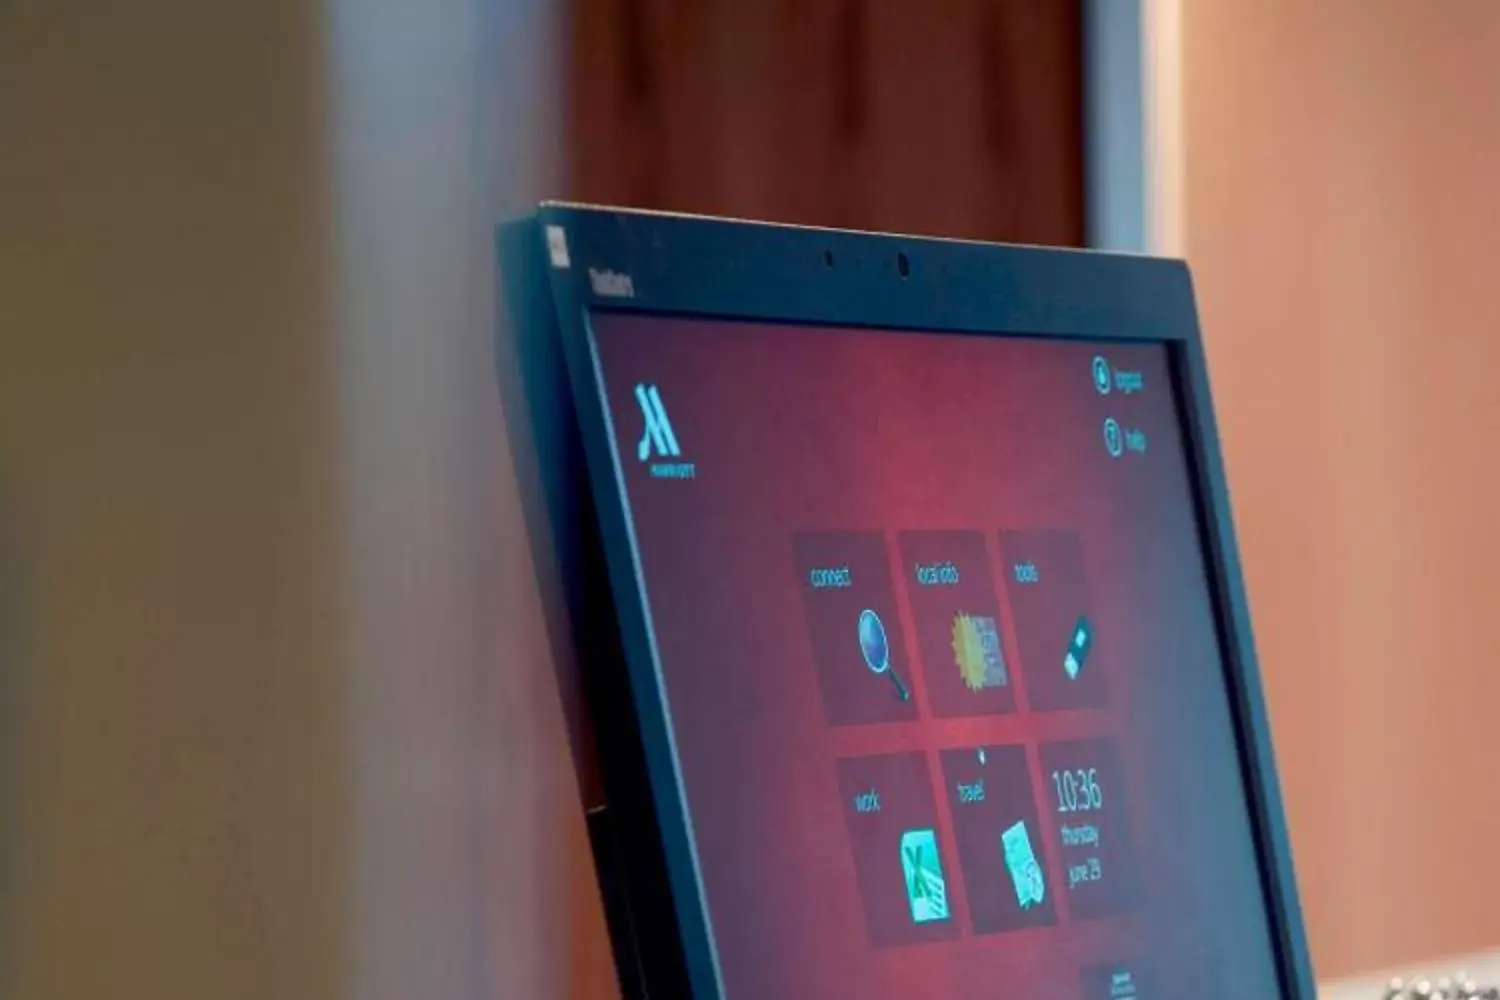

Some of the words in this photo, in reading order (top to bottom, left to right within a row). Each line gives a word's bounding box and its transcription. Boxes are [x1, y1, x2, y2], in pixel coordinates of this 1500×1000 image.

[810, 565, 852, 587] connect
[854, 789, 881, 813] work
[957, 779, 986, 804] travel
[1053, 768, 1102, 812] 10:36
[1061, 822, 1099, 848] thursday
[1069, 864, 1088, 889] june
